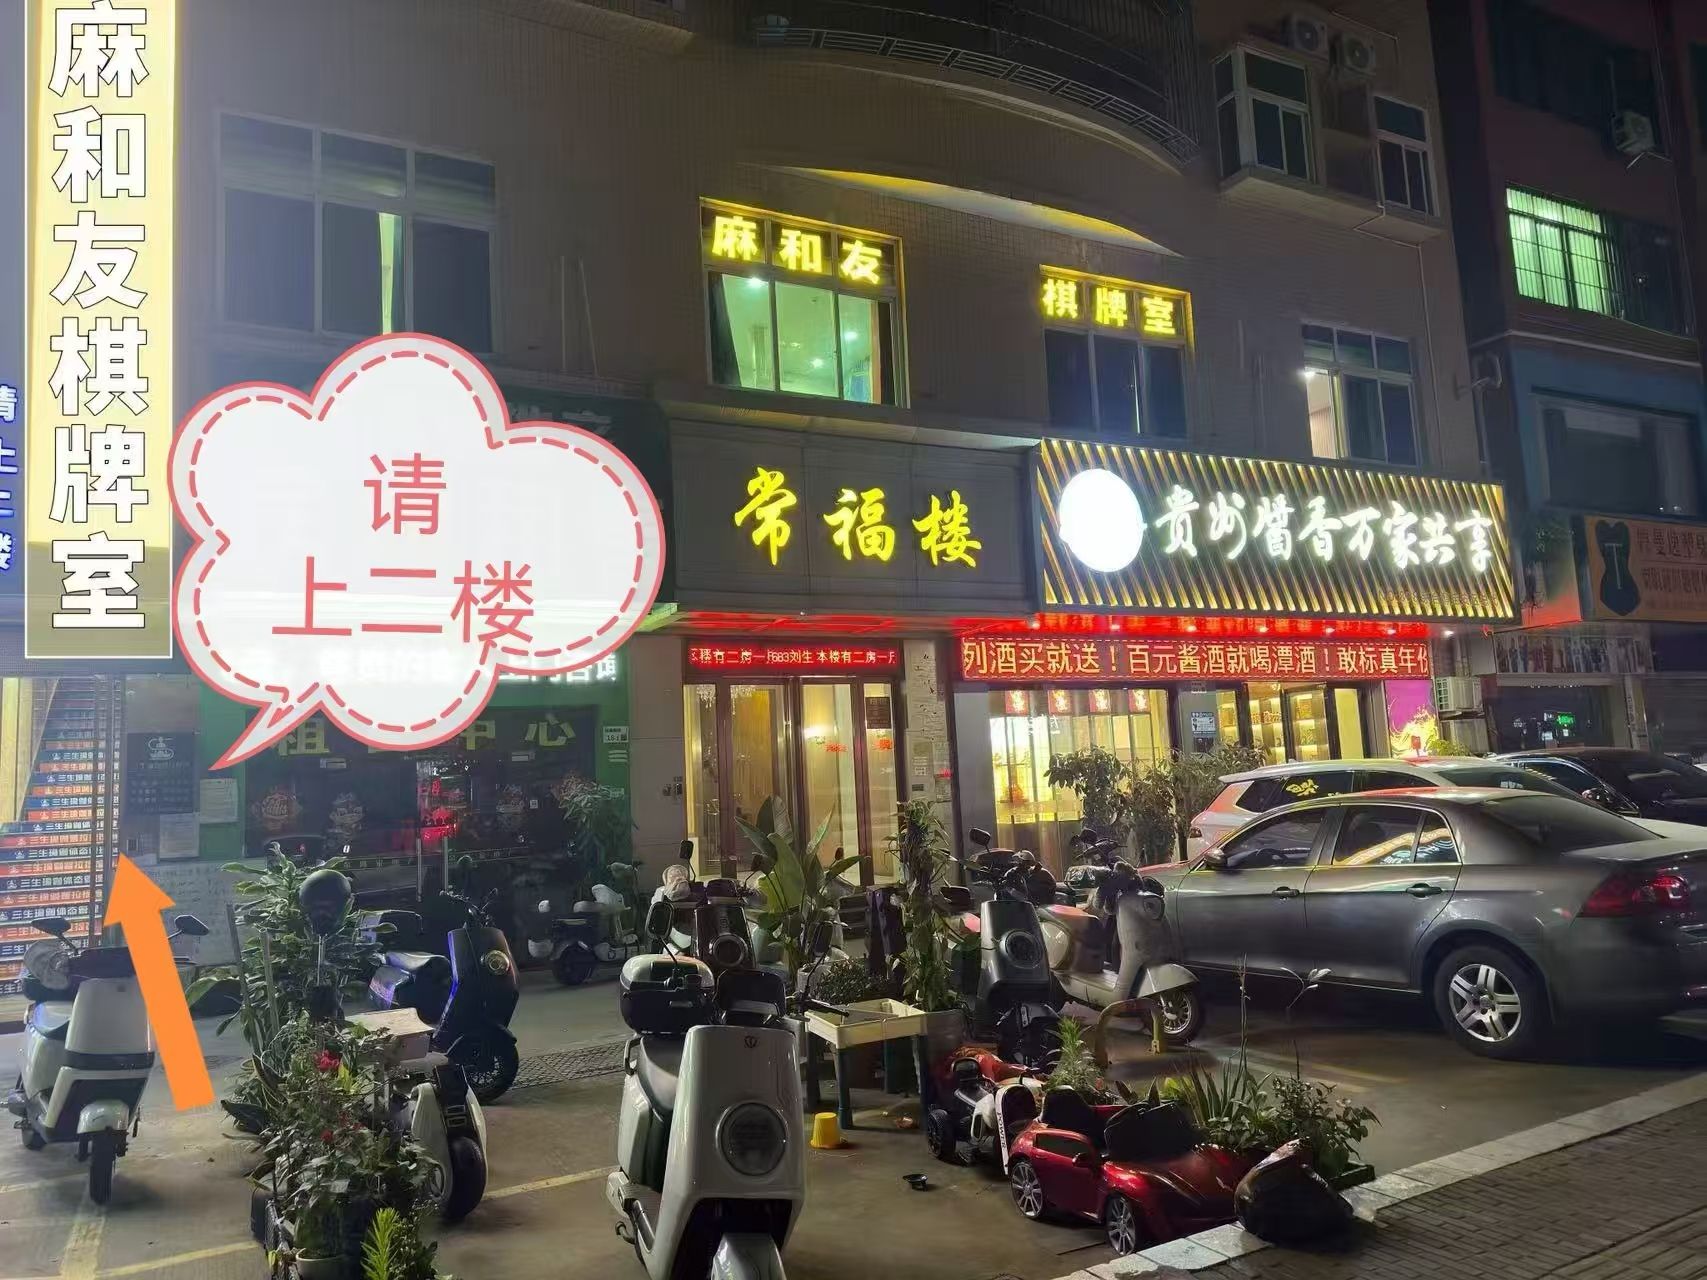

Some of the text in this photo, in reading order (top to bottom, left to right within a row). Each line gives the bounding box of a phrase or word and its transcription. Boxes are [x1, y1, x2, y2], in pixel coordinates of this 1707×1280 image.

[711, 214, 883, 286] 麻和友
[1041, 277, 1177, 336] 棋牌室
[734, 466, 982, 568] 常福楼
[277, 712, 577, 756] 租中心
